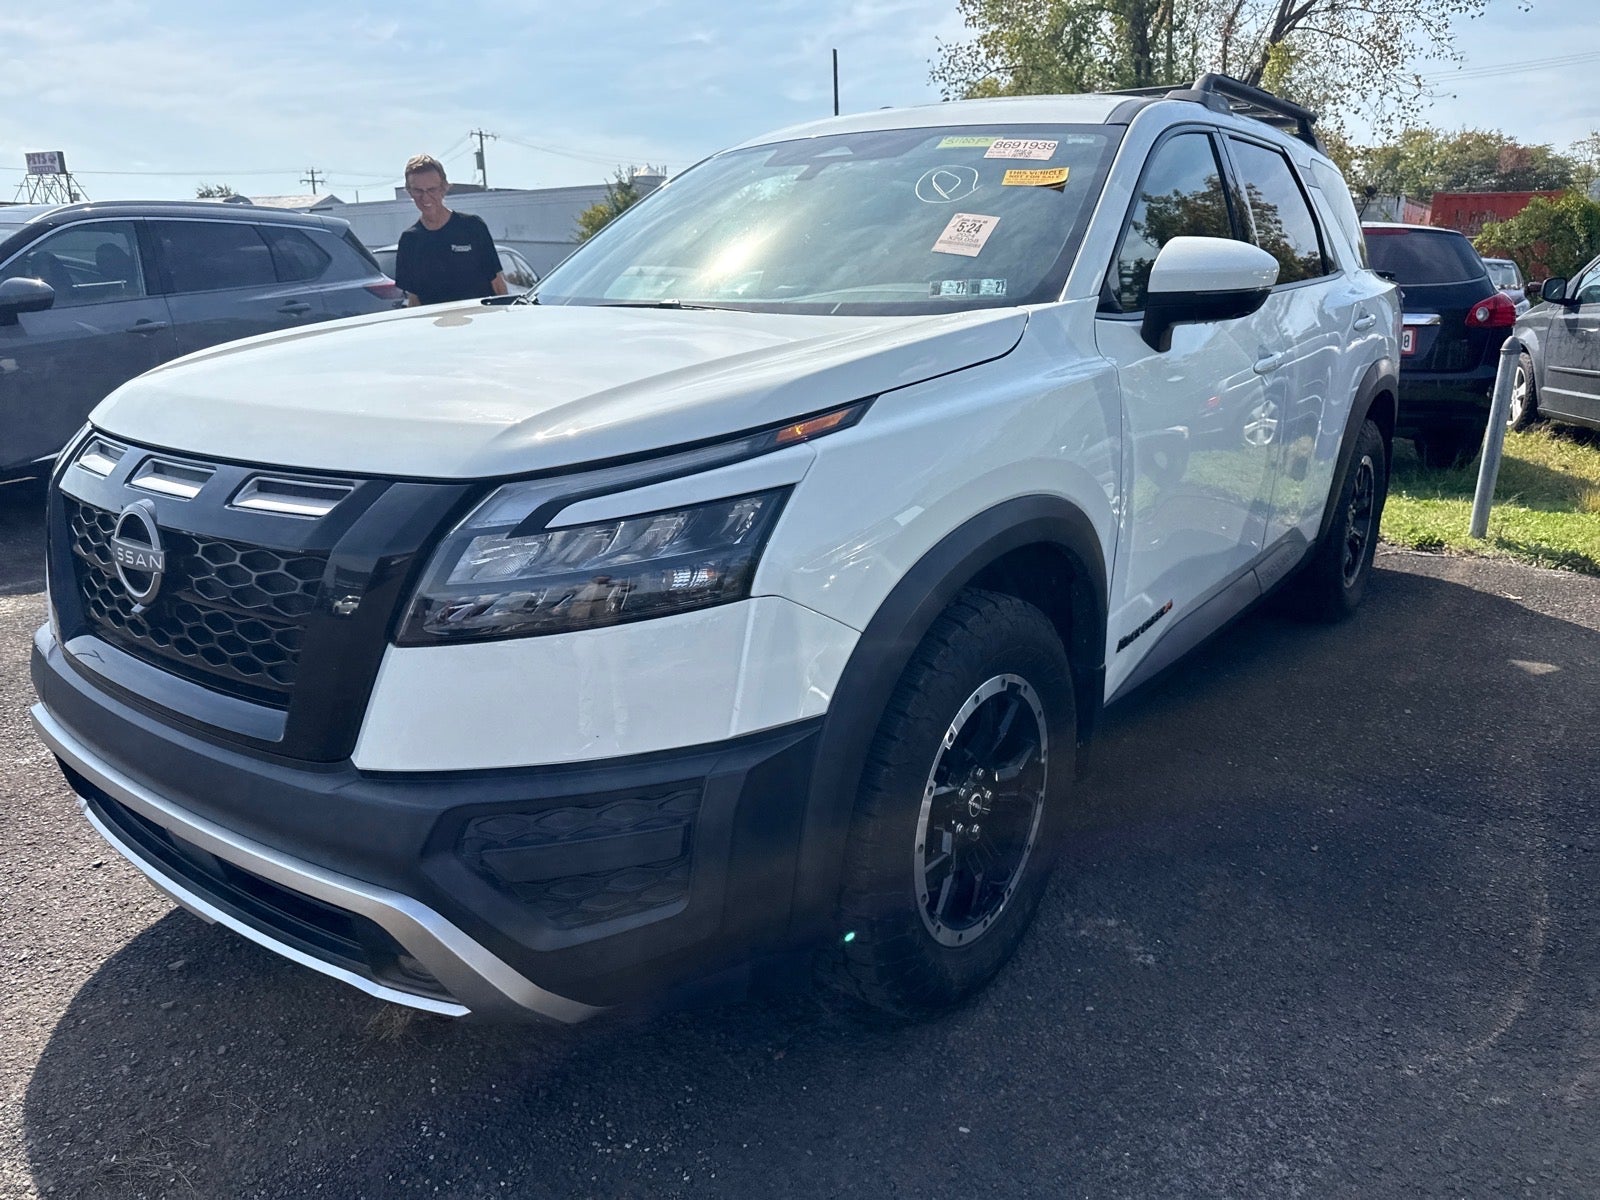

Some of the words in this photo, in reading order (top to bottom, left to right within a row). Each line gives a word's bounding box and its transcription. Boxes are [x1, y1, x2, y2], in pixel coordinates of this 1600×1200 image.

[994, 141, 1057, 150] 8691939
[956, 221, 983, 233] 5:24
[996, 280, 1005, 294] 27
[112, 546, 163, 570] SSAN
